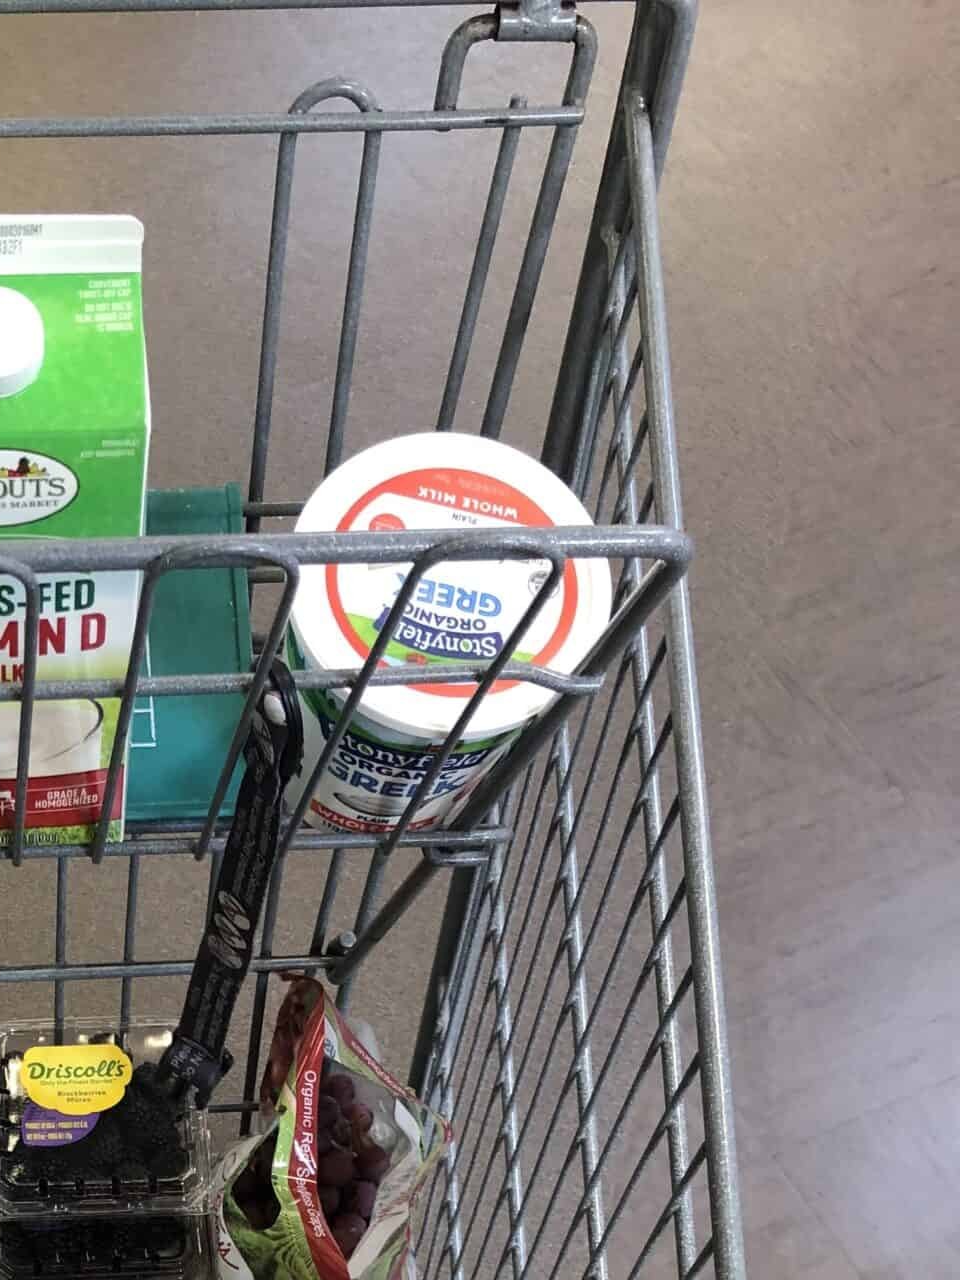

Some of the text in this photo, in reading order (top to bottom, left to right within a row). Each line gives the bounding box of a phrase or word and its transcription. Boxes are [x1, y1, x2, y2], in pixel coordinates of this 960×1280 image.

[10, 500, 59, 510] MARKET
[418, 485, 518, 520] WHOLE MILK
[452, 512, 478, 525] PLAIN
[403, 604, 486, 631] ORGANIC
[80, 612, 107, 651] D
[394, 621, 497, 658] Stonyfiel
[356, 814, 391, 825] PLAIN
[27, 1059, 125, 1080] Driscoll's
[299, 1069, 317, 1129] Organic
